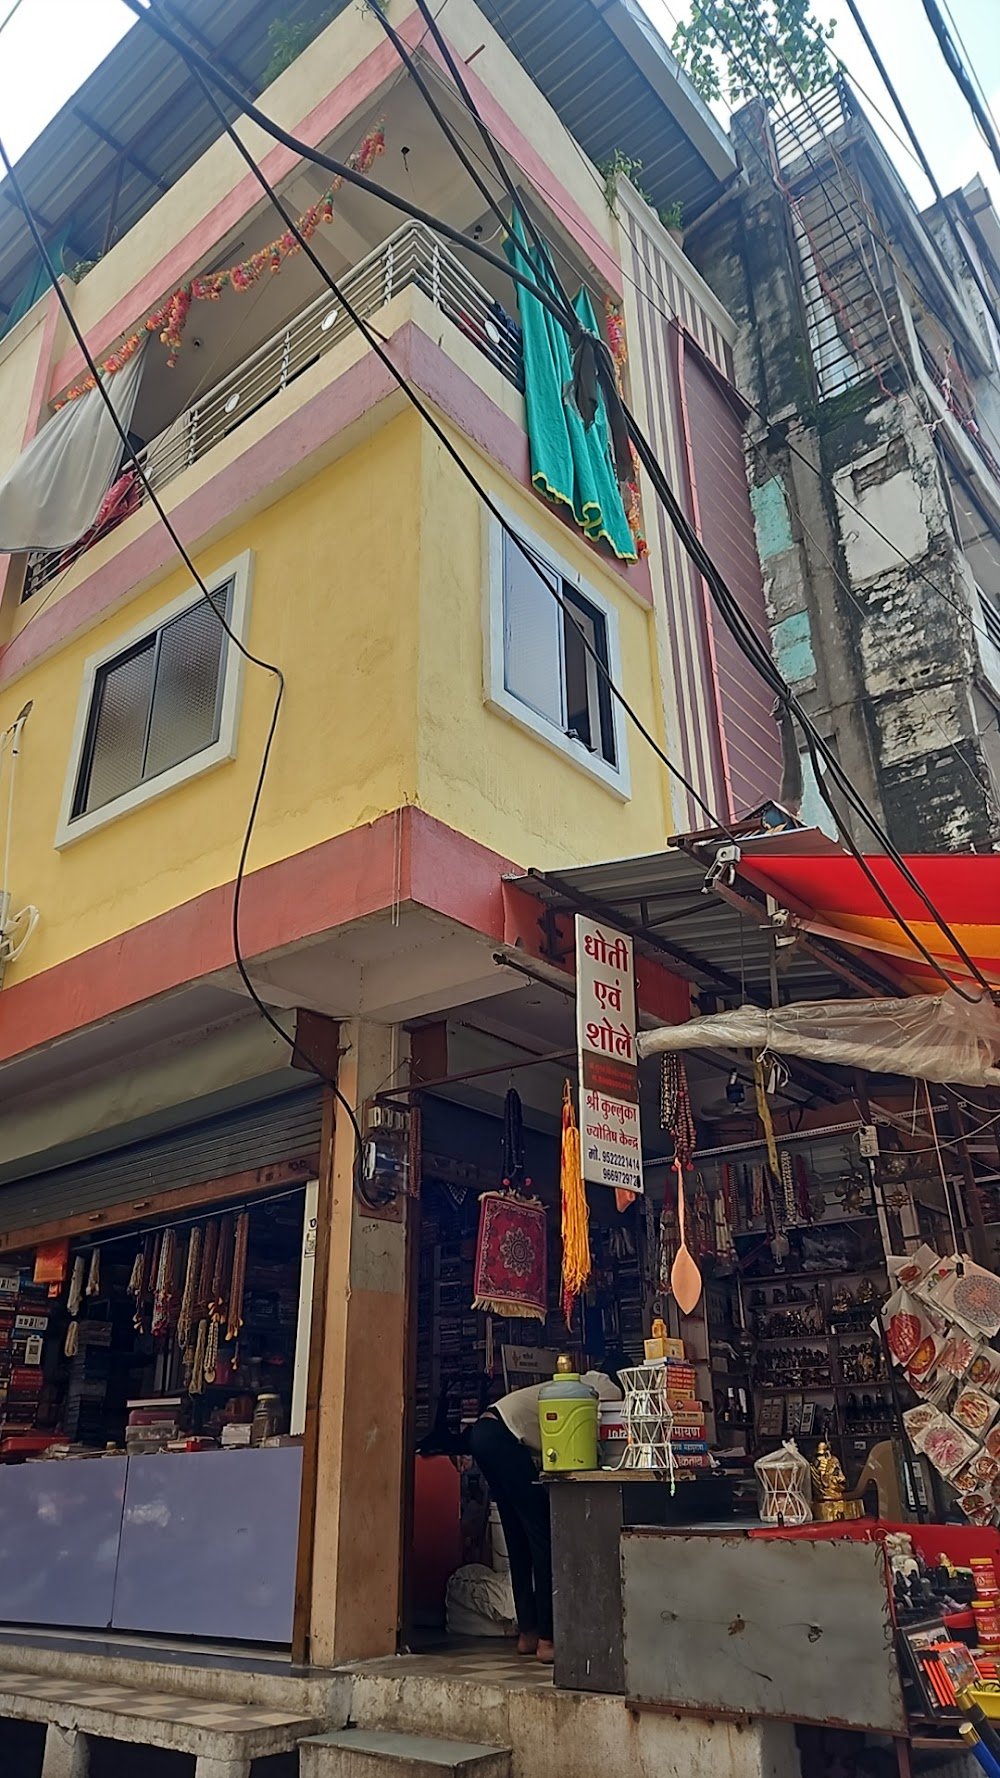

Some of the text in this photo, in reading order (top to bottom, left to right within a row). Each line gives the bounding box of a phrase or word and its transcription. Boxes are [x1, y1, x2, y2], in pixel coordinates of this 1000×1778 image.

[584, 930, 630, 973] धोती
[593, 978, 622, 1012] एवं
[586, 1017, 633, 1059] शोले
[586, 1089, 599, 1112] श्री
[586, 1123, 639, 1150] ज्योतिष केन्द्र
[588, 1144, 640, 1171] मो. 9522221414
[603, 1168, 641, 1188] 966972972
